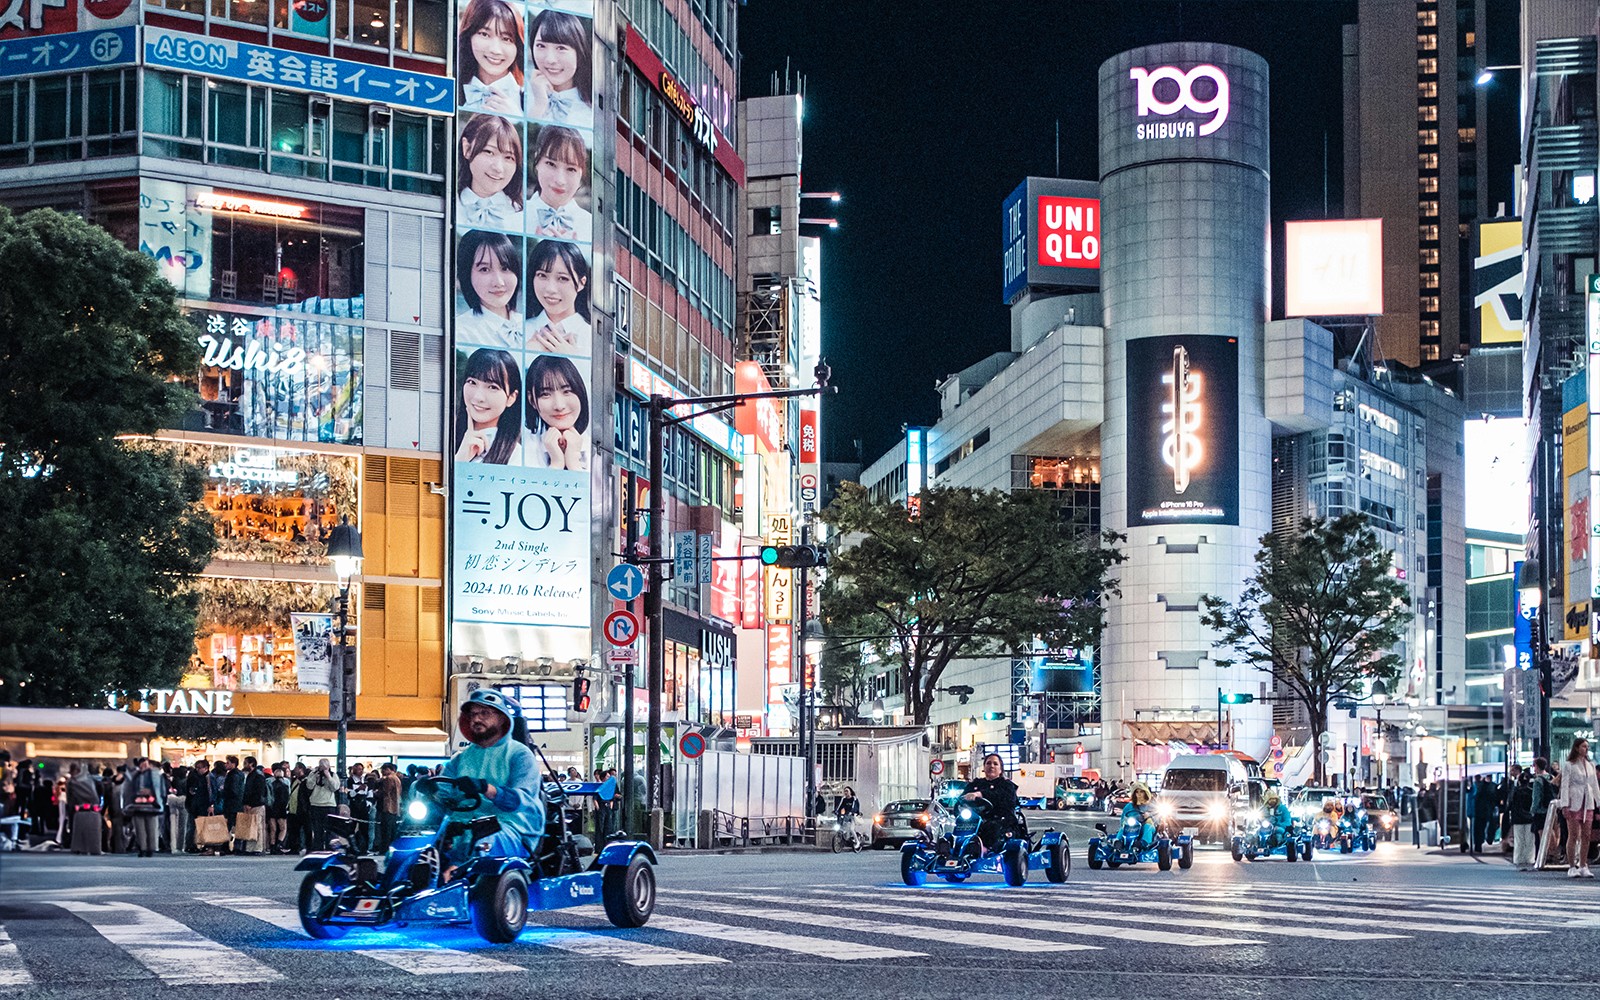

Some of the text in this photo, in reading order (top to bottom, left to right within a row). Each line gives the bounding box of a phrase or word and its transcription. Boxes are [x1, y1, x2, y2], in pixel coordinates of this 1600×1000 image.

[0, 41, 80, 66] ーオン
[94, 37, 118, 58] 6F
[155, 35, 228, 69] AEON
[246, 49, 448, 104] 英会話イーオン
[1130, 63, 1230, 136] 109
[1136, 121, 1195, 140] SHIBUYA
[1008, 199, 1022, 244] THE
[1044, 204, 1095, 233] UNI
[1004, 235, 1026, 288] PRIME
[1044, 234, 1100, 263] QLO
[206, 314, 250, 336] 渋谷
[197, 334, 307, 375] Ushi8
[730, 434, 744, 458] 4F
[802, 424, 815, 452] 免税
[801, 474, 816, 500] OS
[494, 540, 549, 556] 2nd Single
[683, 534, 694, 583] 渋谷駅前
[701, 536, 711, 582] スクランブル式
[464, 553, 578, 575] 初恋シンデレラ
[462, 581, 583, 600] 2024.10.16 Release!
[471, 606, 495, 617] Sony
[701, 629, 732, 668] LUSH
